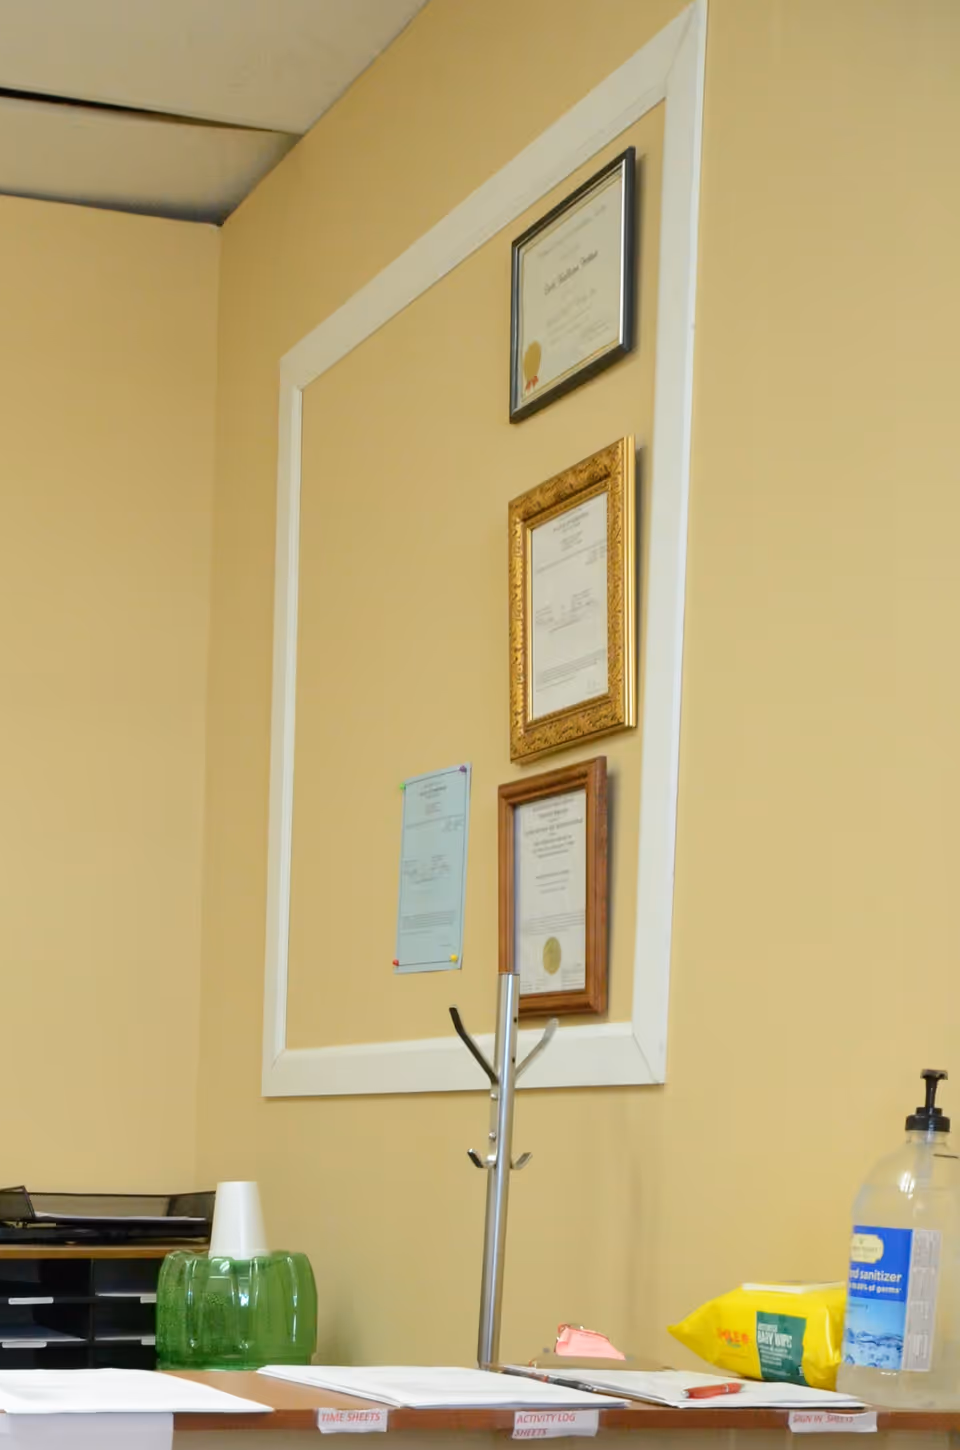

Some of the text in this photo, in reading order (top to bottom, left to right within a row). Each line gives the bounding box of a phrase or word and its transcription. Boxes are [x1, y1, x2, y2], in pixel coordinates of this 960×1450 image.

[860, 1270, 902, 1282] sanitizer
[320, 1412, 381, 1422] TIME SHEETS
[516, 1414, 576, 1424] ACTIVITY LOG
[514, 1428, 548, 1437] SHEETS
